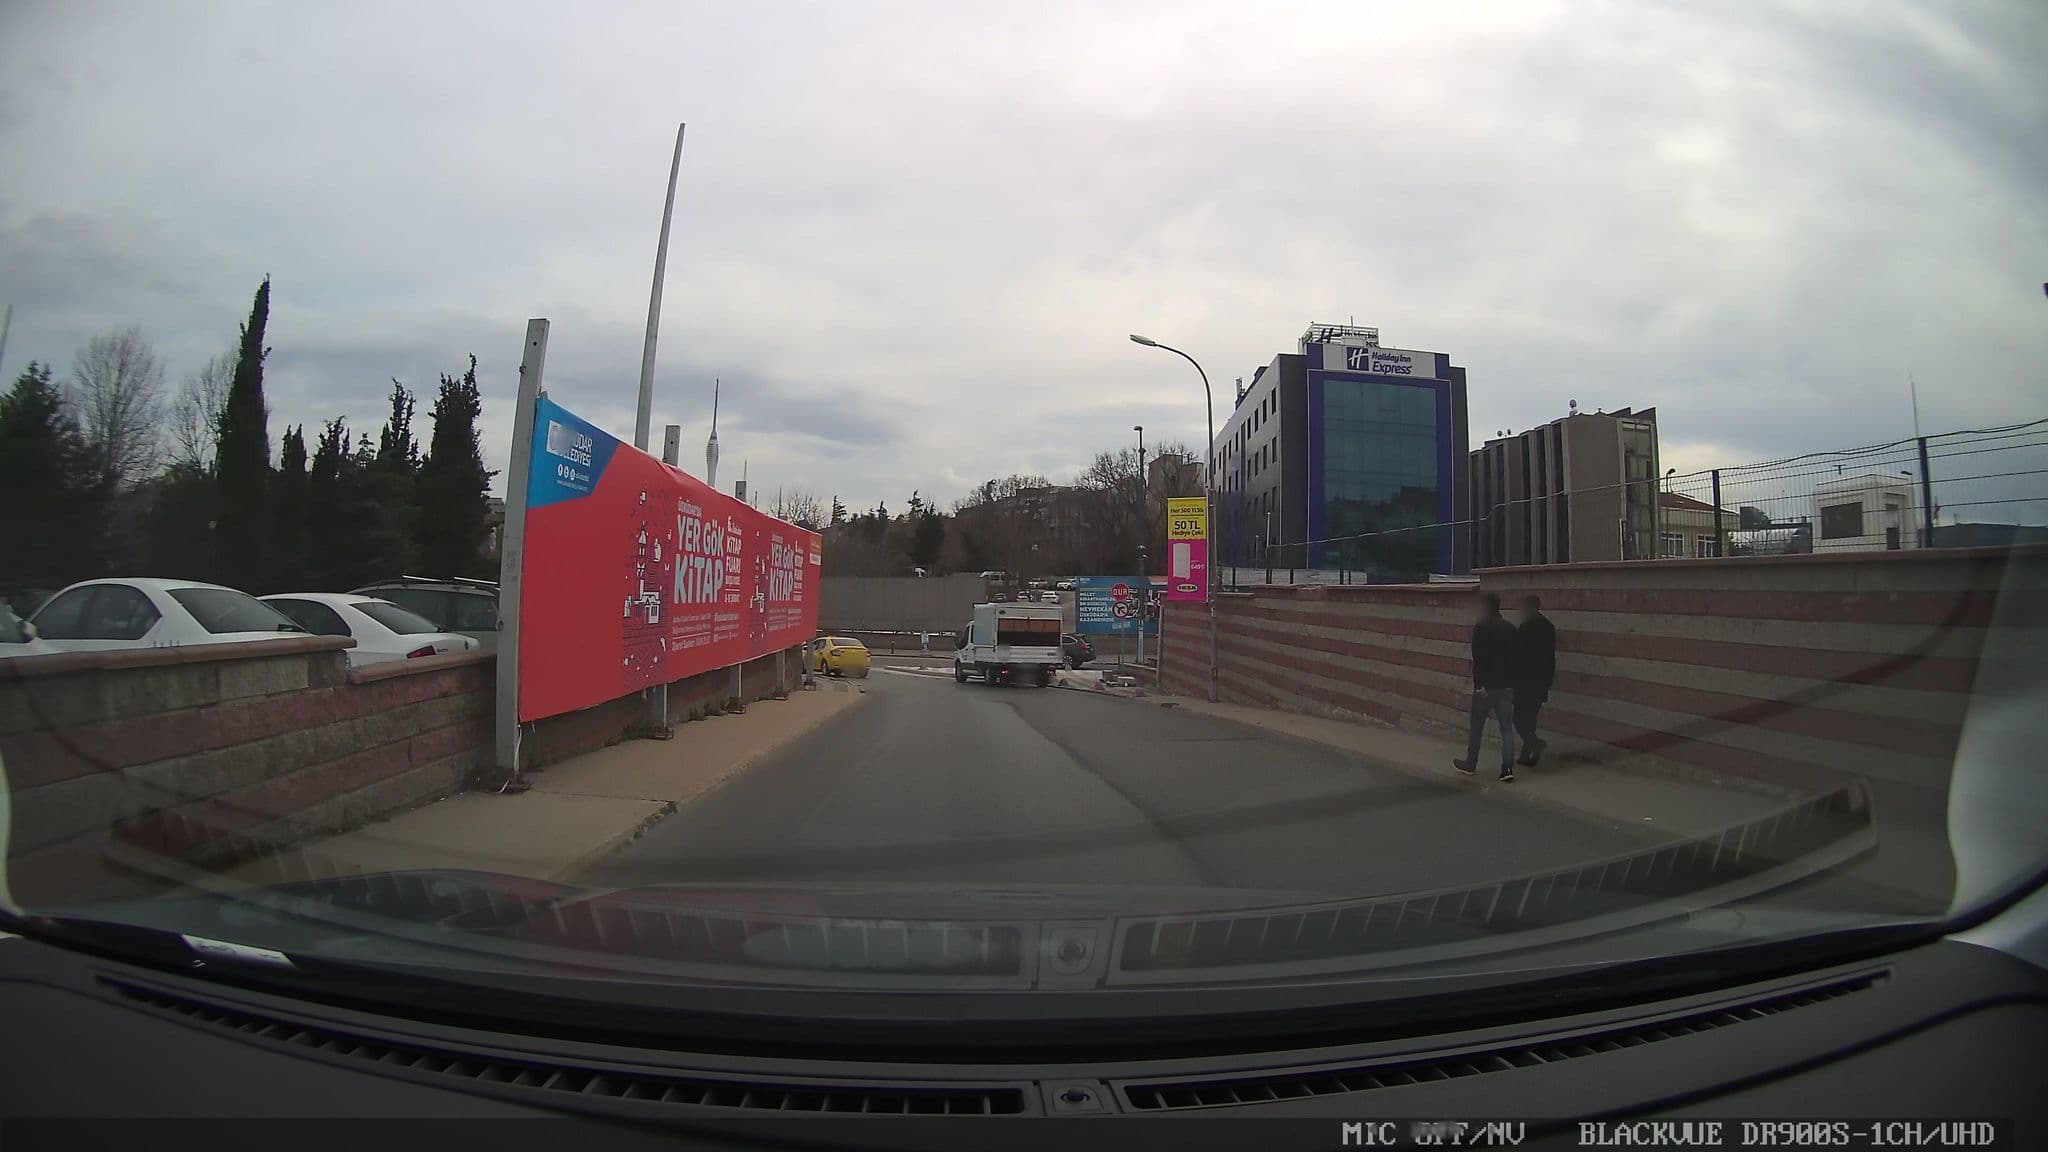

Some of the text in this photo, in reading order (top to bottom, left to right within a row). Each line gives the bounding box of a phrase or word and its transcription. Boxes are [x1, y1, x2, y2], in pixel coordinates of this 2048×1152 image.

[1372, 351, 1411, 364] Holiday Inn
[1372, 361, 1412, 375] Express
[1174, 520, 1201, 530] 50 TL
[677, 514, 725, 557] YER GÖK
[771, 543, 783, 568] YER
[674, 553, 724, 605] KİTAP
[769, 567, 794, 602] KİTAP
[1113, 588, 1128, 596] DUR
